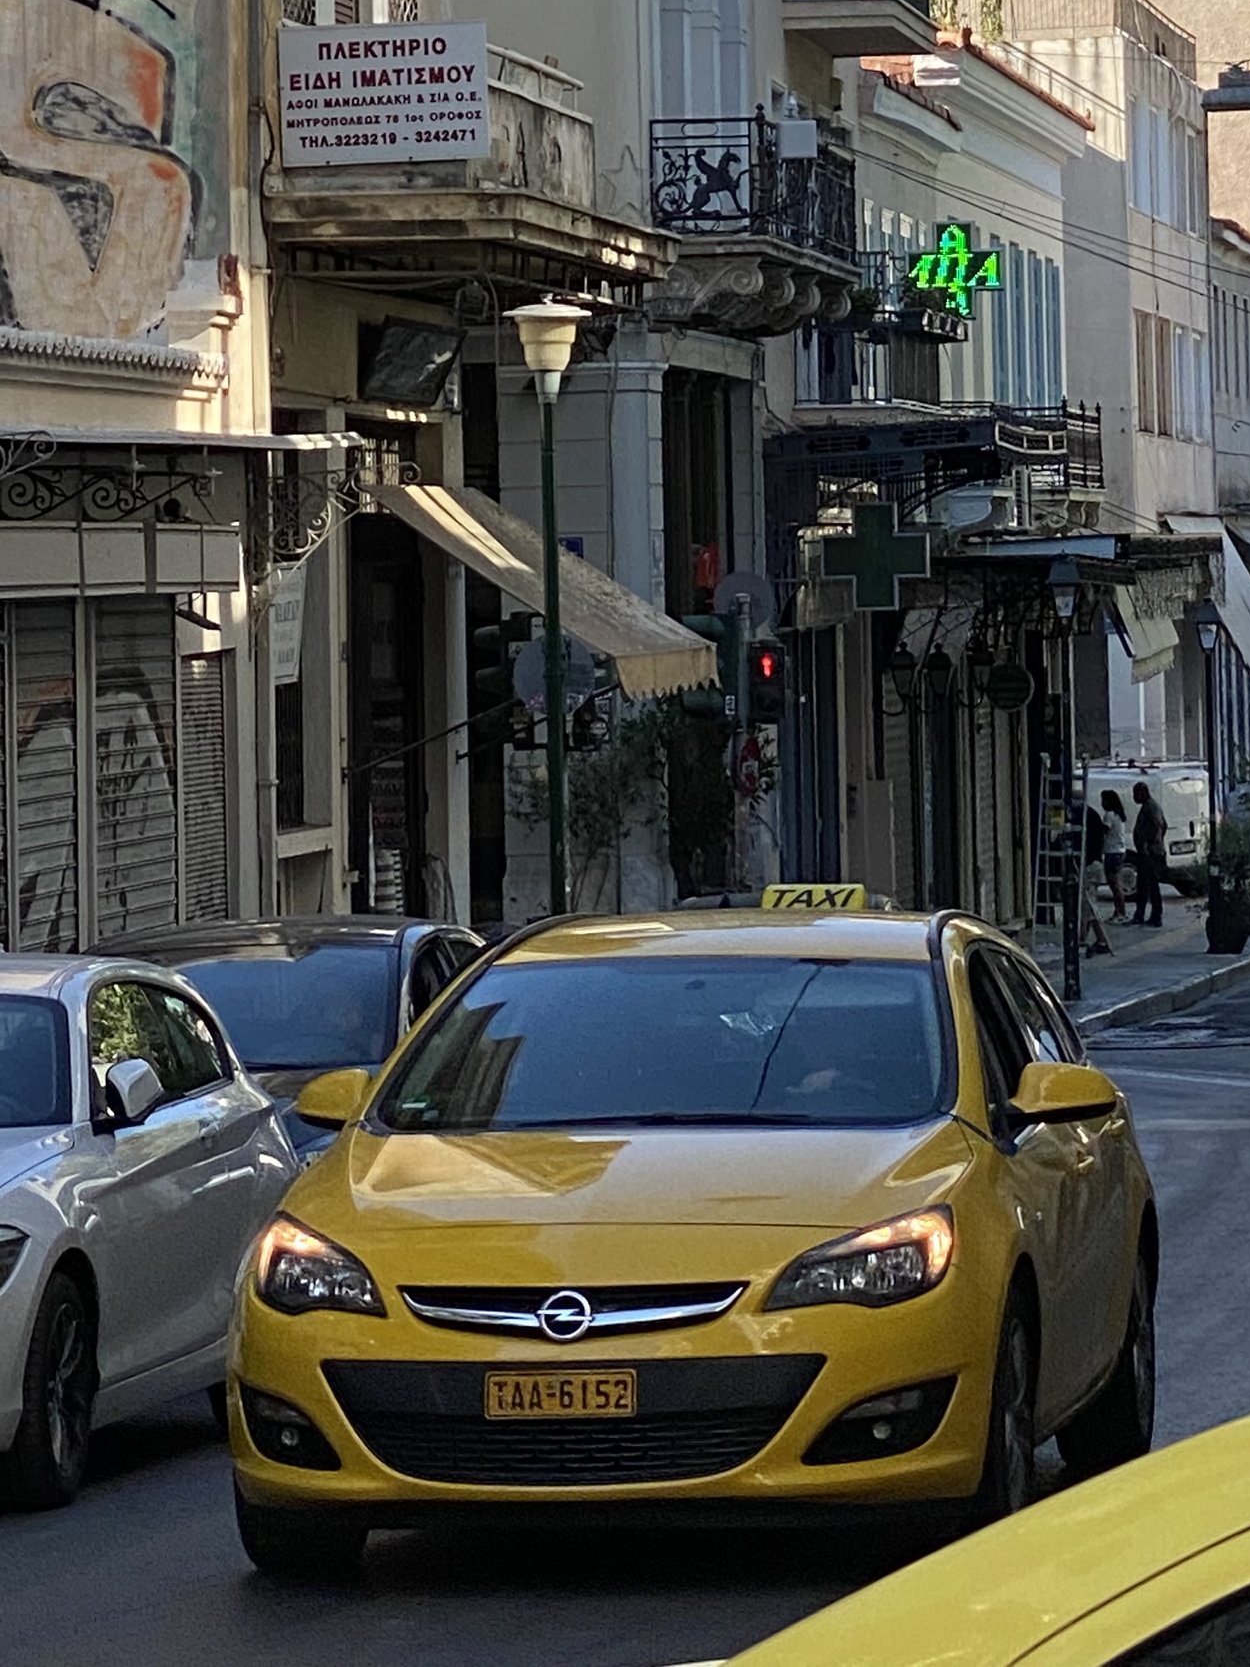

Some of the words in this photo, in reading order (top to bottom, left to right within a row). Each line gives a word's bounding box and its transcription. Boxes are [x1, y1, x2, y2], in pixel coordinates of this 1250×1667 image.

[318, 37, 447, 60] ΠΛΕΚΤΗΡΙΟ
[289, 71, 341, 91] ΕΙΔΗ
[352, 65, 476, 88] ΙΜΑΤΙΣΜΟΥ
[286, 98, 318, 110] ΑΦΟΙ
[323, 94, 411, 109] ΜΑΝΩΛΑΚΑΚΗ
[416, 94, 425, 104] &
[429, 92, 450, 103] ΣΙΑ
[455, 91, 483, 102] Ο.Ε.
[286, 115, 381, 129] ΜΗΤΡΟΠΟΛΕΩΣ
[429, 110, 482, 122] ΟΡΟΦΟΣ
[415, 129, 476, 143] 3242471
[772, 889, 856, 908] TAXI
